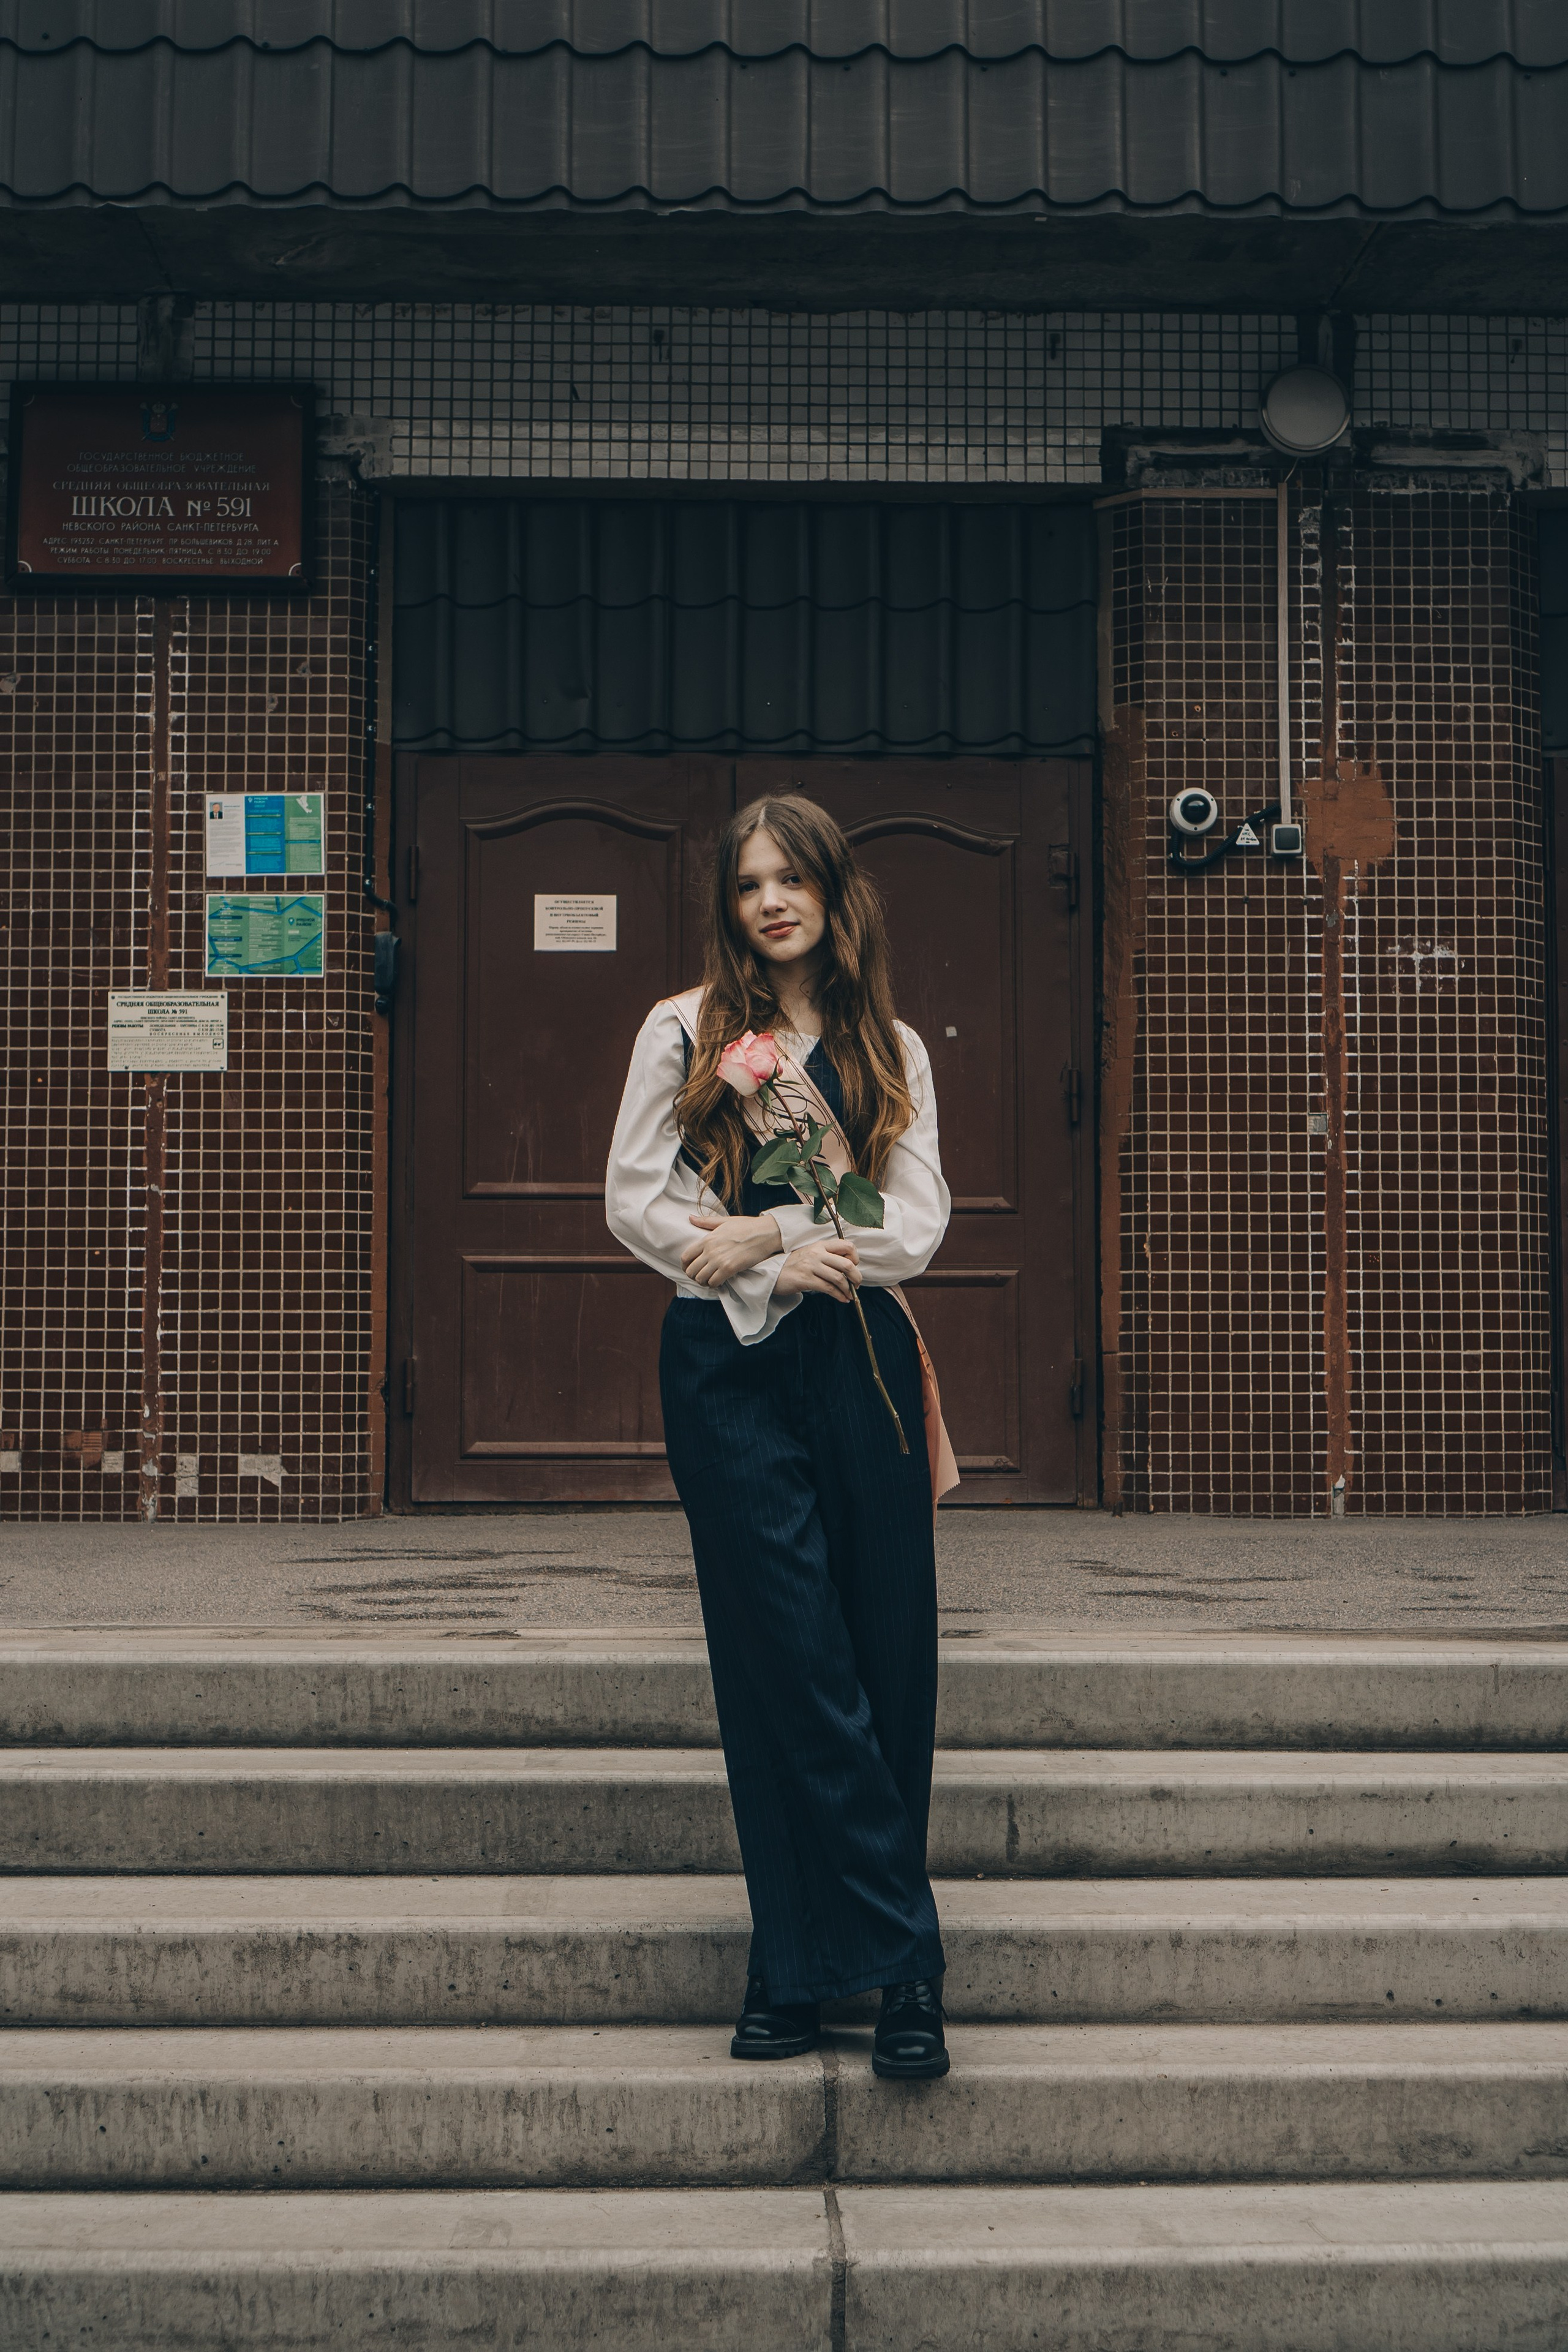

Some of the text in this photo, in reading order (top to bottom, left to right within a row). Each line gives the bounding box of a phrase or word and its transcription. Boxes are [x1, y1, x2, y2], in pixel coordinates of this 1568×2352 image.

[79, 452, 244, 461] ГОСУДАРСТВЕННОЕ БЮДЖЕТНОЕ
[67, 464, 256, 473] ОБЩЕОБРАЗОВАТЕЛЬНОЕ УЧРЕЖДЕНИЕ
[53, 481, 270, 491] СРЕДНЯЯ ОБЩЕОБРАЗОВАТЕЛЬНАЯ
[72, 497, 175, 516] ШКОЛА
[216, 496, 251, 517] 591
[62, 521, 260, 532] НЕВСКОГО РАЙОНА САНКТ-ПЕТЕРБУРГА
